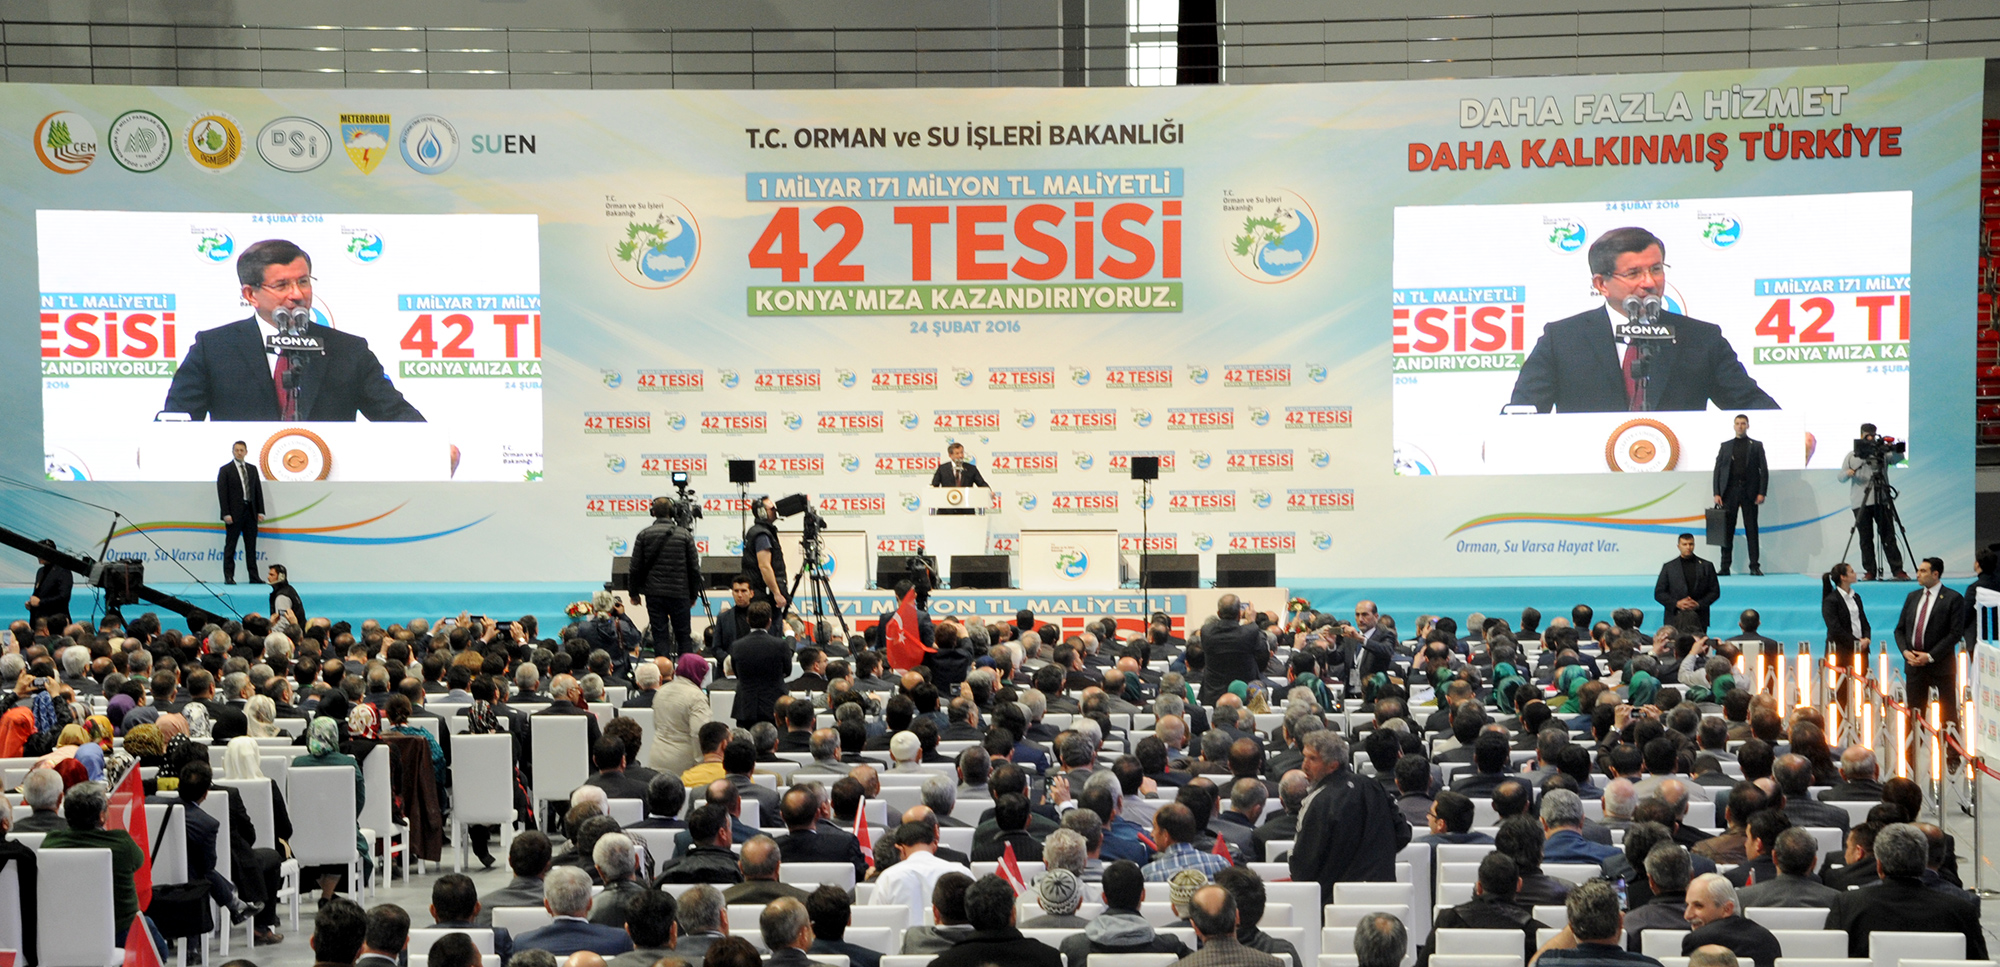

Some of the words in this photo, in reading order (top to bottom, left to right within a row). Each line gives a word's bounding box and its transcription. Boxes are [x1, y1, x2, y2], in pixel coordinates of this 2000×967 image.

[1460, 96, 1562, 128] DAHA
[1574, 92, 1692, 124] FAZLA
[747, 129, 786, 149] T.C.
[794, 126, 888, 149] ORMAN
[894, 131, 921, 148] ve
[927, 125, 959, 148] SU
[966, 120, 1042, 151] İŞLERİ
[1049, 118, 1185, 147] BAKANLIĞI
[73, 142, 97, 154] ÇEM
[471, 134, 537, 154] SUEN
[1408, 140, 1510, 172] DAHA
[1521, 133, 1728, 172] KALKINMIŞ
[1739, 123, 1902, 161] TÜRKİYE
[758, 178, 769, 198] 1
[867, 177, 900, 197] 171
[1007, 175, 1036, 196] TL
[1605, 203, 1618, 211] 24
[1621, 202, 1652, 212] ŞUBAT
[1656, 201, 1680, 209] 2016
[267, 214, 298, 224] ŞUBAT
[301, 215, 323, 223] 2016
[748, 205, 865, 283] 42
[1838, 279, 1860, 291] 171
[58, 295, 78, 308] TL
[476, 297, 497, 309] 171
[931, 284, 1178, 311] KAZANDIRIYORUZ.
[1409, 291, 1428, 303] TL
[1755, 296, 1835, 344] 42
[910, 321, 928, 334] 24
[933, 319, 983, 337] ŞUBAT
[987, 320, 1021, 334] 2016
[1622, 325, 1670, 335] KONYA
[271, 336, 319, 347] KONYA
[400, 313, 475, 358] 42
[638, 375, 656, 387] 42
[756, 375, 774, 387] 42
[872, 374, 890, 386] 42
[989, 372, 1007, 385] 42
[1107, 371, 1125, 384] 42
[1225, 370, 1243, 383] 42
[585, 417, 603, 429] 42
[702, 417, 720, 429] 42
[818, 417, 836, 429] 42
[934, 416, 952, 428] 42
[1051, 414, 1069, 427] 42
[1168, 413, 1186, 426] 42
[1286, 412, 1304, 424] 42
[642, 459, 660, 472] 42
[759, 459, 777, 471] 42
[876, 458, 894, 470] 42
[992, 457, 1010, 470] 42
[1109, 456, 1127, 468] 42
[1227, 455, 1245, 467] 42
[587, 500, 604, 511] 42
[704, 499, 721, 511] 42
[820, 499, 838, 511] 42
[1053, 497, 1071, 509] 42
[1170, 496, 1188, 508] 42
[1288, 495, 1306, 507] 42
[878, 540, 896, 552] 42
[994, 539, 1012, 551] 42
[1230, 537, 1248, 550] 42
[1456, 540, 1500, 554] Orman,
[1504, 540, 1518, 553] Su
[1521, 540, 1554, 553] Varsa
[1557, 539, 1595, 556] Hayat
[1597, 539, 1620, 553] Var.
[154, 548, 168, 561] Su
[171, 549, 204, 561] Varsa
[985, 599, 1017, 613] TL
